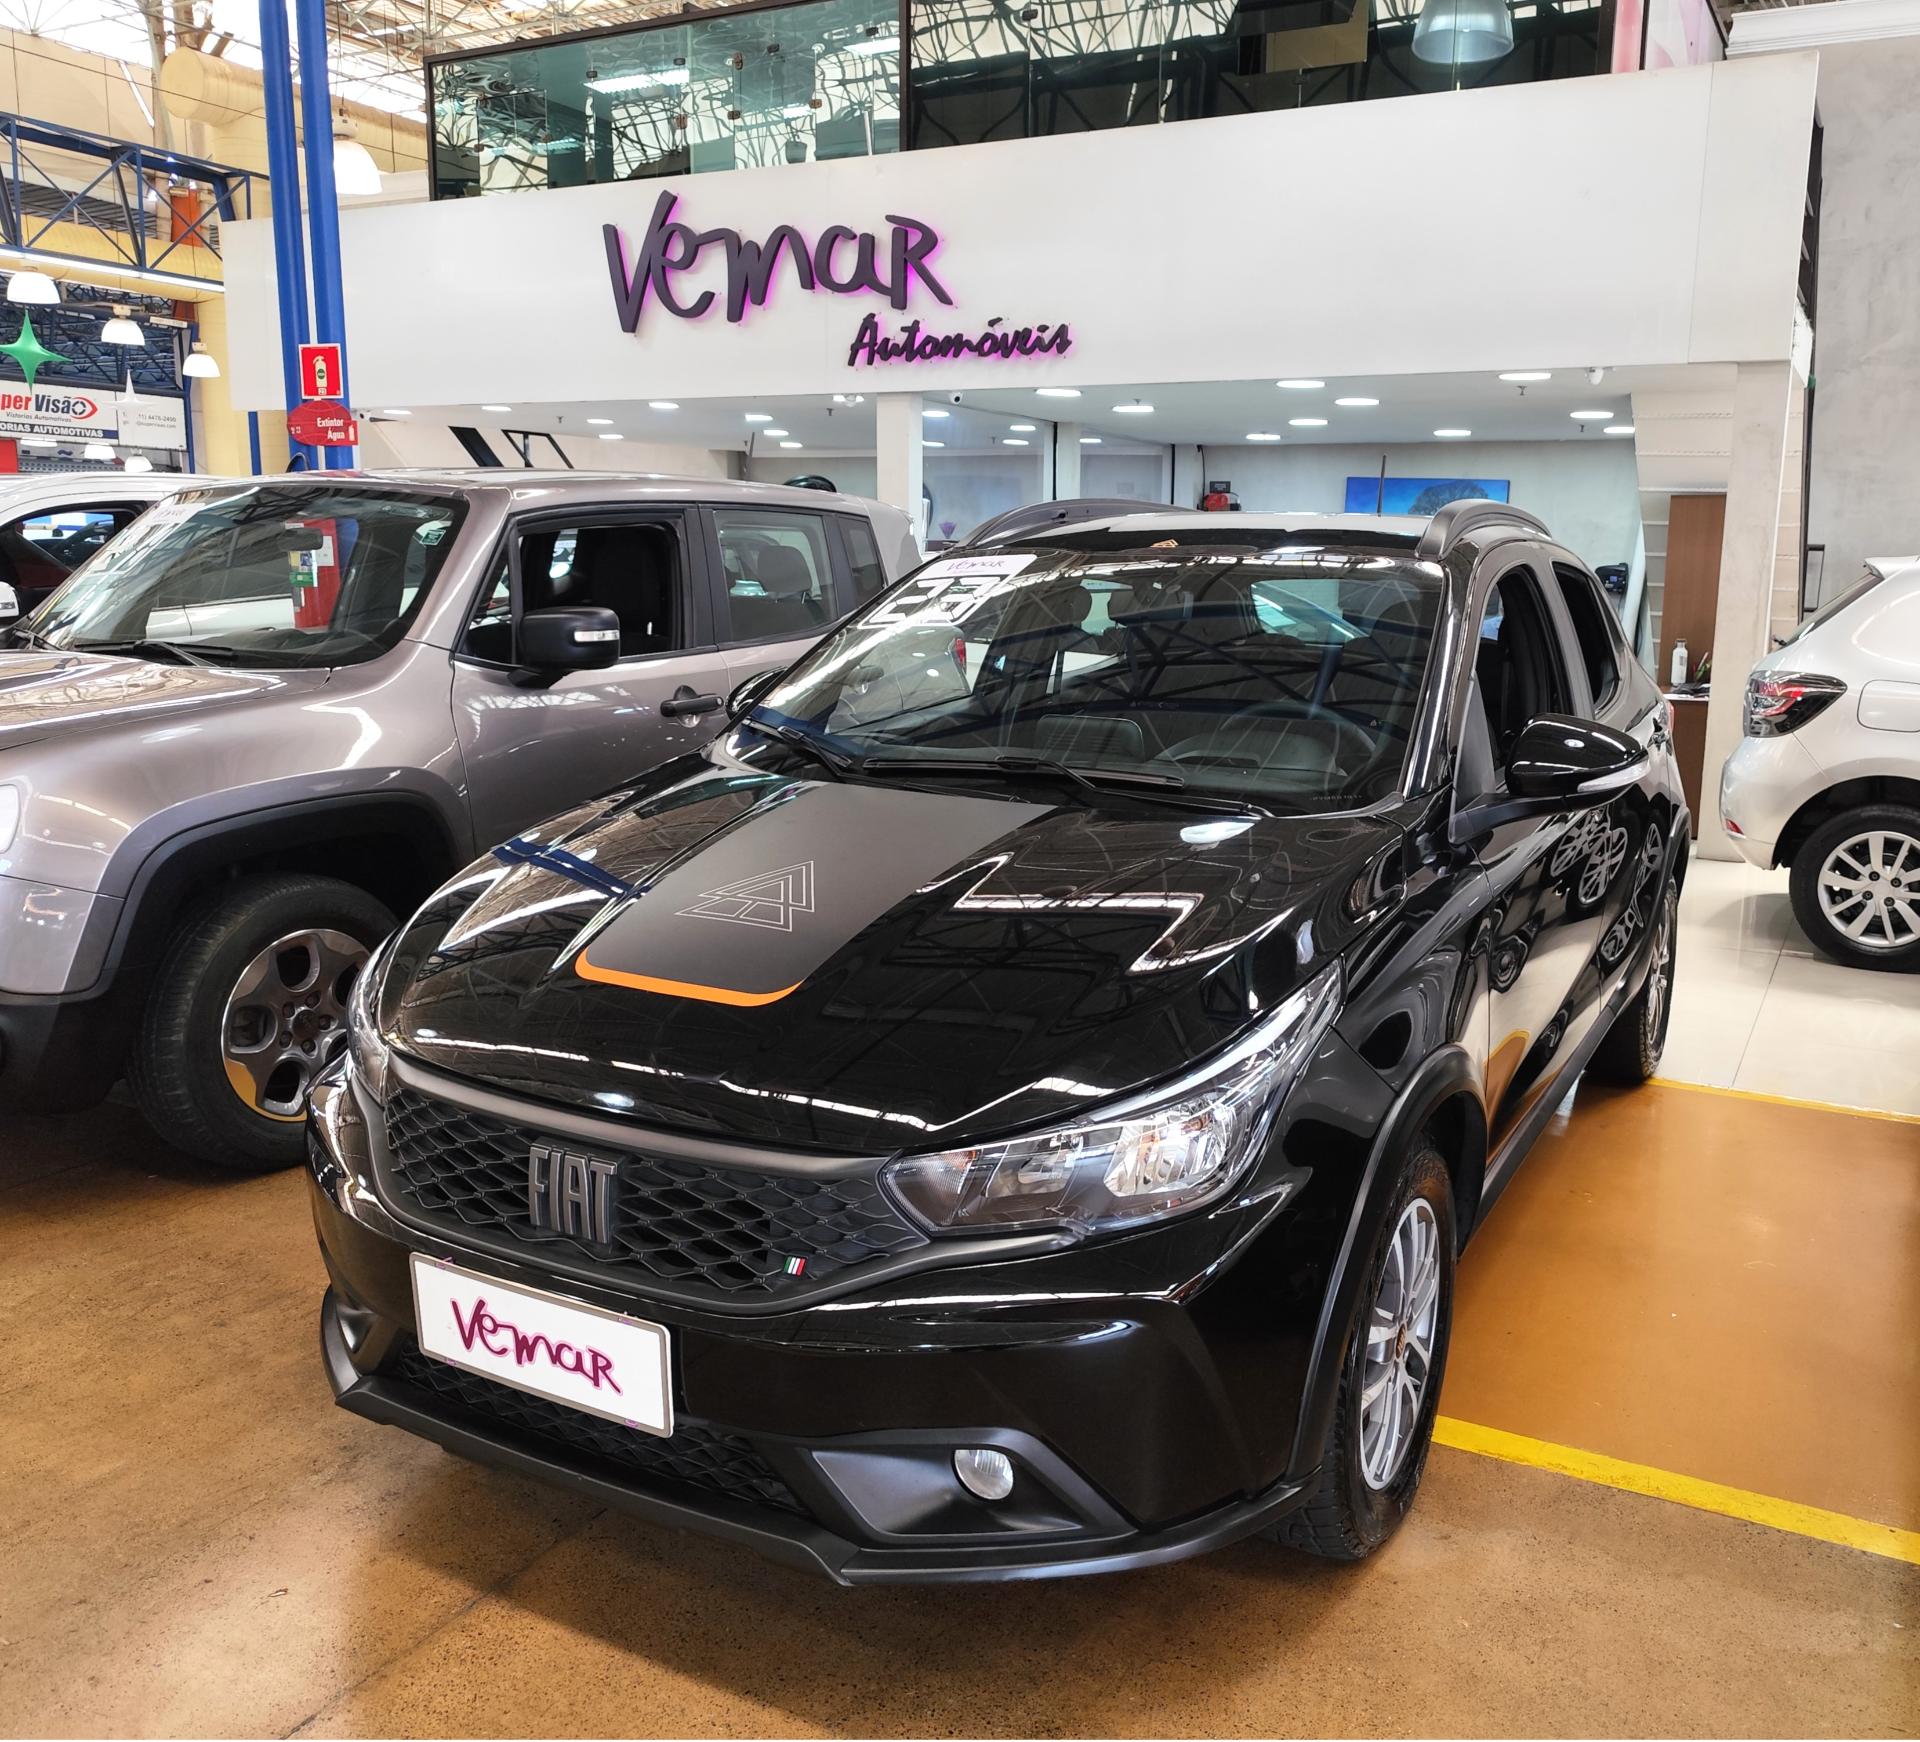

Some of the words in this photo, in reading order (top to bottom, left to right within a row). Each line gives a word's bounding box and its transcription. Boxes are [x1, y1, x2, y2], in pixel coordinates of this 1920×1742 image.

[847, 312, 1072, 367] Automóveis
[35, 394, 86, 415] Visão
[6, 412, 33, 420] Vistorias
[34, 414, 72, 422] Automotivas
[316, 417, 345, 427] Extintor
[33, 425, 104, 438] AUTOMOTIVAS
[327, 426, 346, 441] Água
[528, 1144, 618, 1245] FIAT
